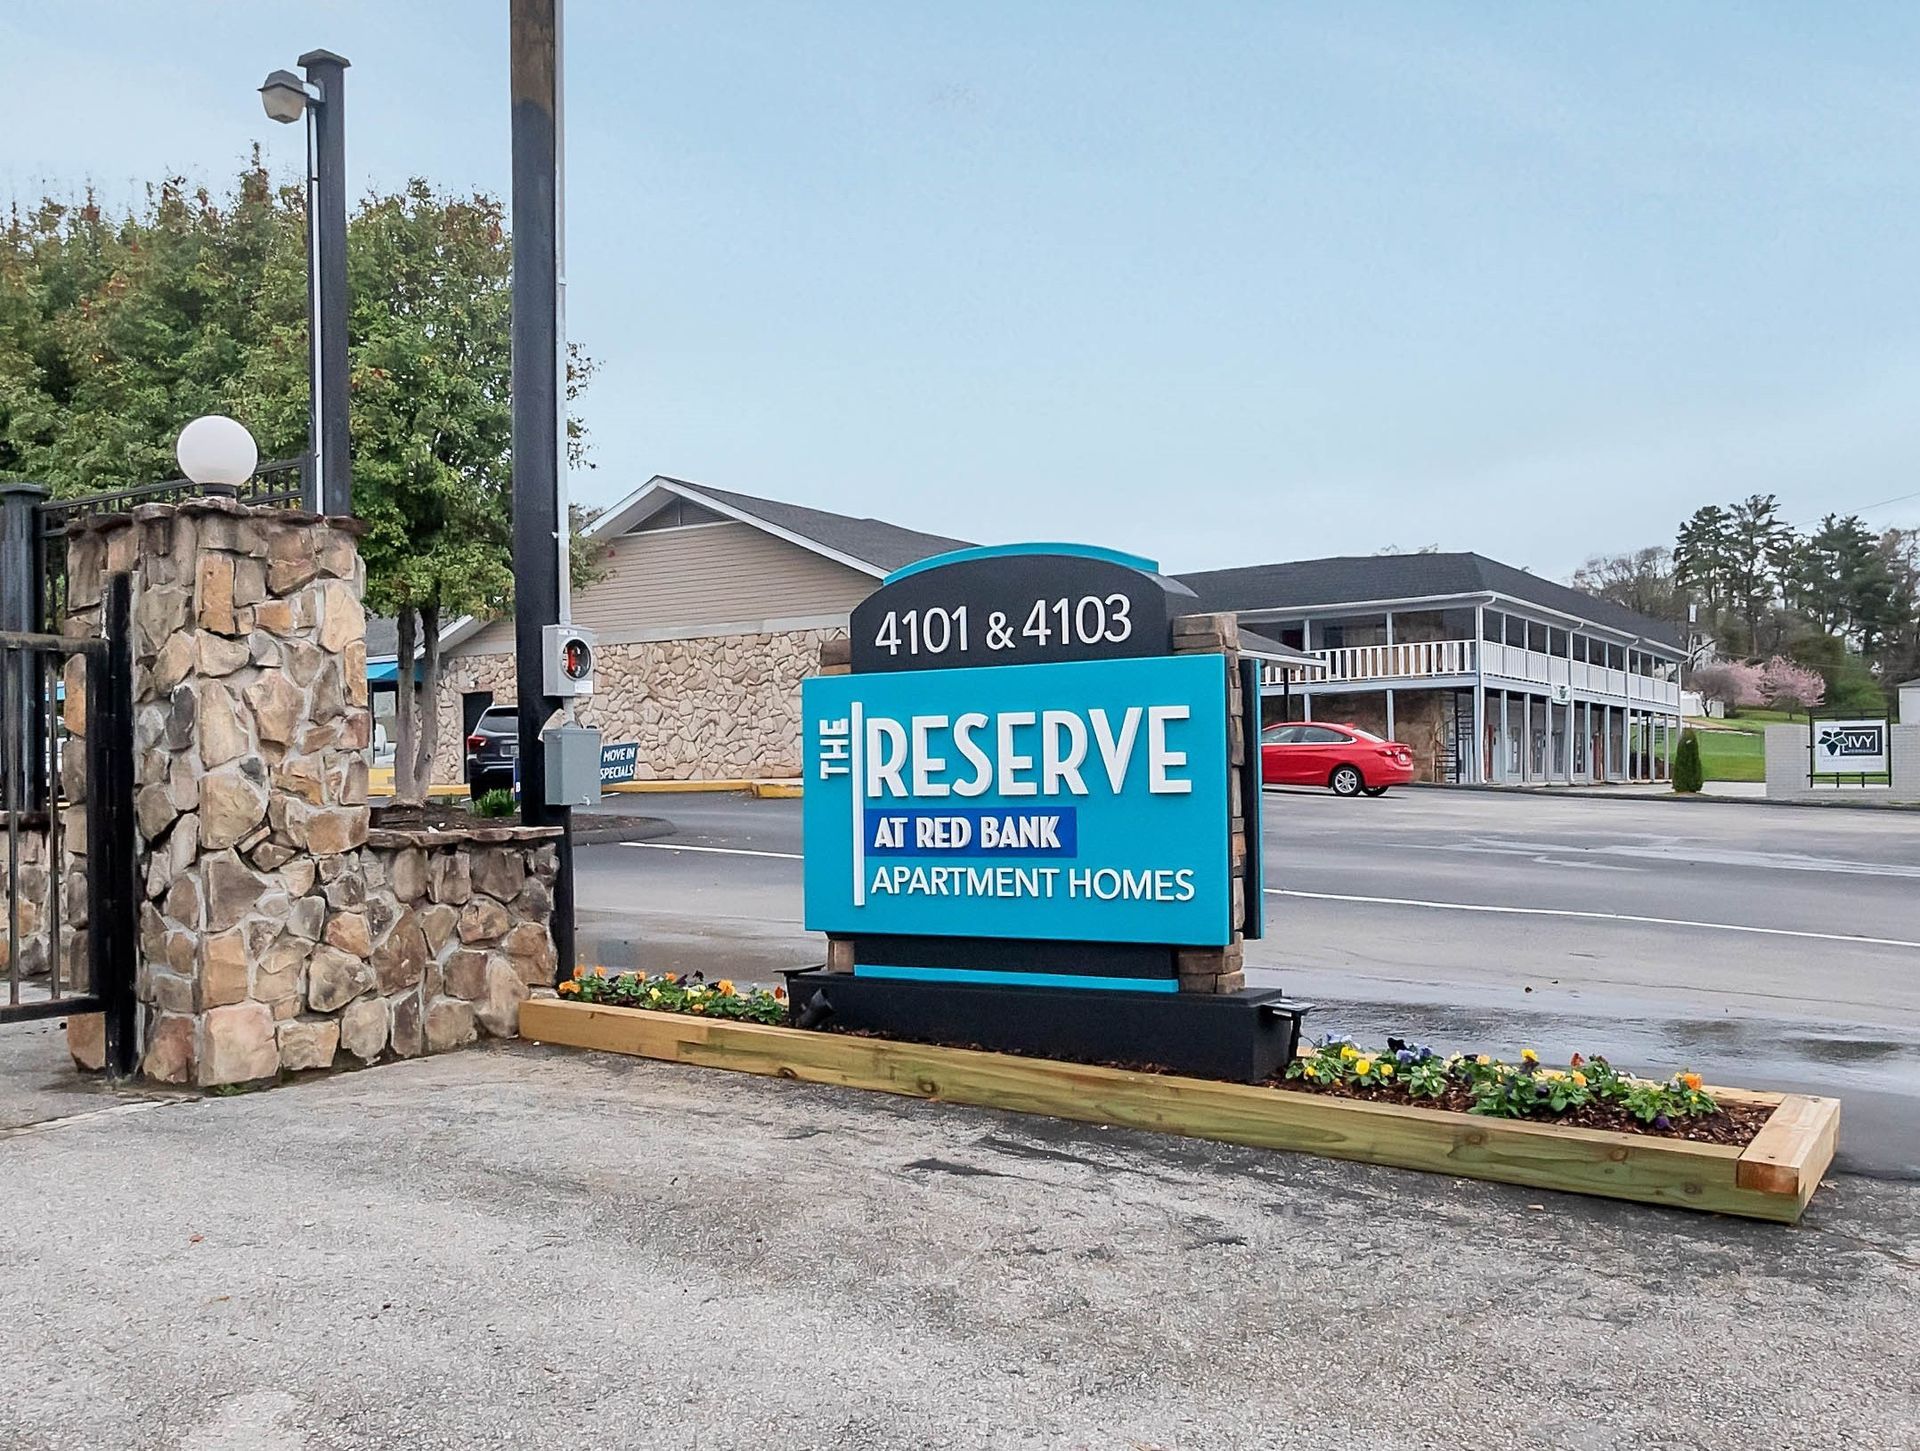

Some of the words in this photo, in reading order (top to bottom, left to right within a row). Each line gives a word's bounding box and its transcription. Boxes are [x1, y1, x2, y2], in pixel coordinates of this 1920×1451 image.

[874, 605, 969, 656] 4101
[985, 610, 1017, 651] &
[1022, 593, 1133, 648] 4103
[604, 748, 626, 762] MOVE
[626, 747, 635, 759] IN
[819, 717, 850, 780] THE
[866, 705, 1193, 798] RESERVE
[1848, 735, 1874, 748] IVY
[600, 764, 634, 780] SPECIALS
[874, 816, 906, 849] AT
[916, 816, 972, 849] RED
[980, 815, 1062, 850] BANK
[870, 866, 1060, 899] APARTMENT
[1068, 868, 1195, 902] HOMES
